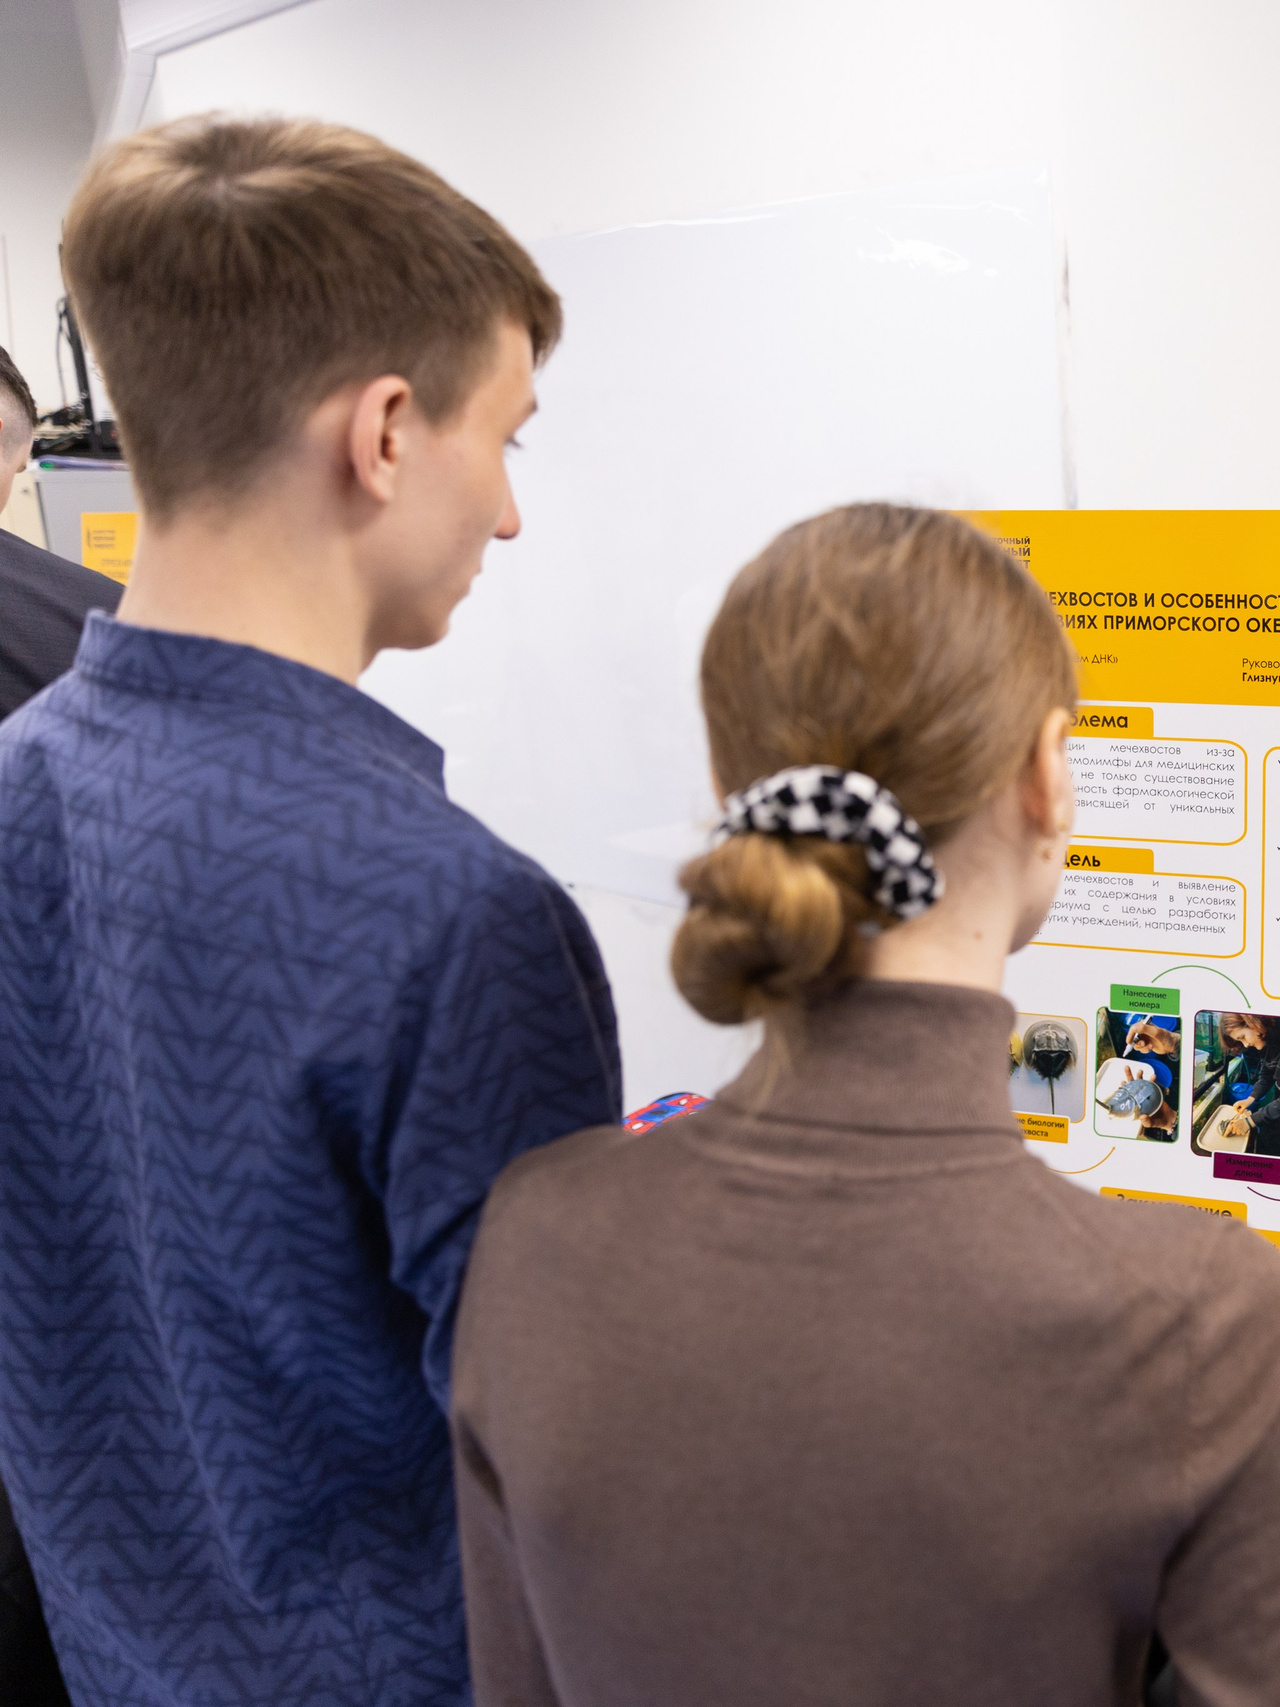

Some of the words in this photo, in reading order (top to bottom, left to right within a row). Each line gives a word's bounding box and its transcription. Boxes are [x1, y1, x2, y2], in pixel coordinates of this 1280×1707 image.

[1045, 592, 1137, 607] ЕХВОСТОВ
[1145, 593, 1155, 607] И
[1104, 615, 1239, 632] ПРИМОРСКОГО
[1110, 744, 1181, 755] мечехвостов
[1207, 748, 1235, 757] из-за
[1135, 760, 1152, 768] для
[1157, 760, 1235, 771] медицинских
[1081, 771, 1094, 779] не
[1102, 772, 1137, 781] только
[1144, 773, 1234, 786] существование
[1113, 784, 1234, 800] фармакологической
[1144, 802, 1155, 810] от
[1170, 804, 1235, 814] уникальных
[1064, 874, 1134, 886] мечехвостов
[1153, 880, 1159, 888] и
[1178, 881, 1236, 893] выявление
[1088, 890, 1157, 902] содержания
[1169, 895, 1174, 903] в
[1187, 896, 1236, 906] условиях
[1122, 906, 1156, 916] целью
[1169, 908, 1235, 921] разработки
[1072, 917, 1141, 928] учреждений,
[1145, 921, 1225, 934] направленных
[1123, 989, 1167, 999] Нанесение
[1129, 1001, 1160, 1010] номера
[1028, 1118, 1064, 1128] биологии
